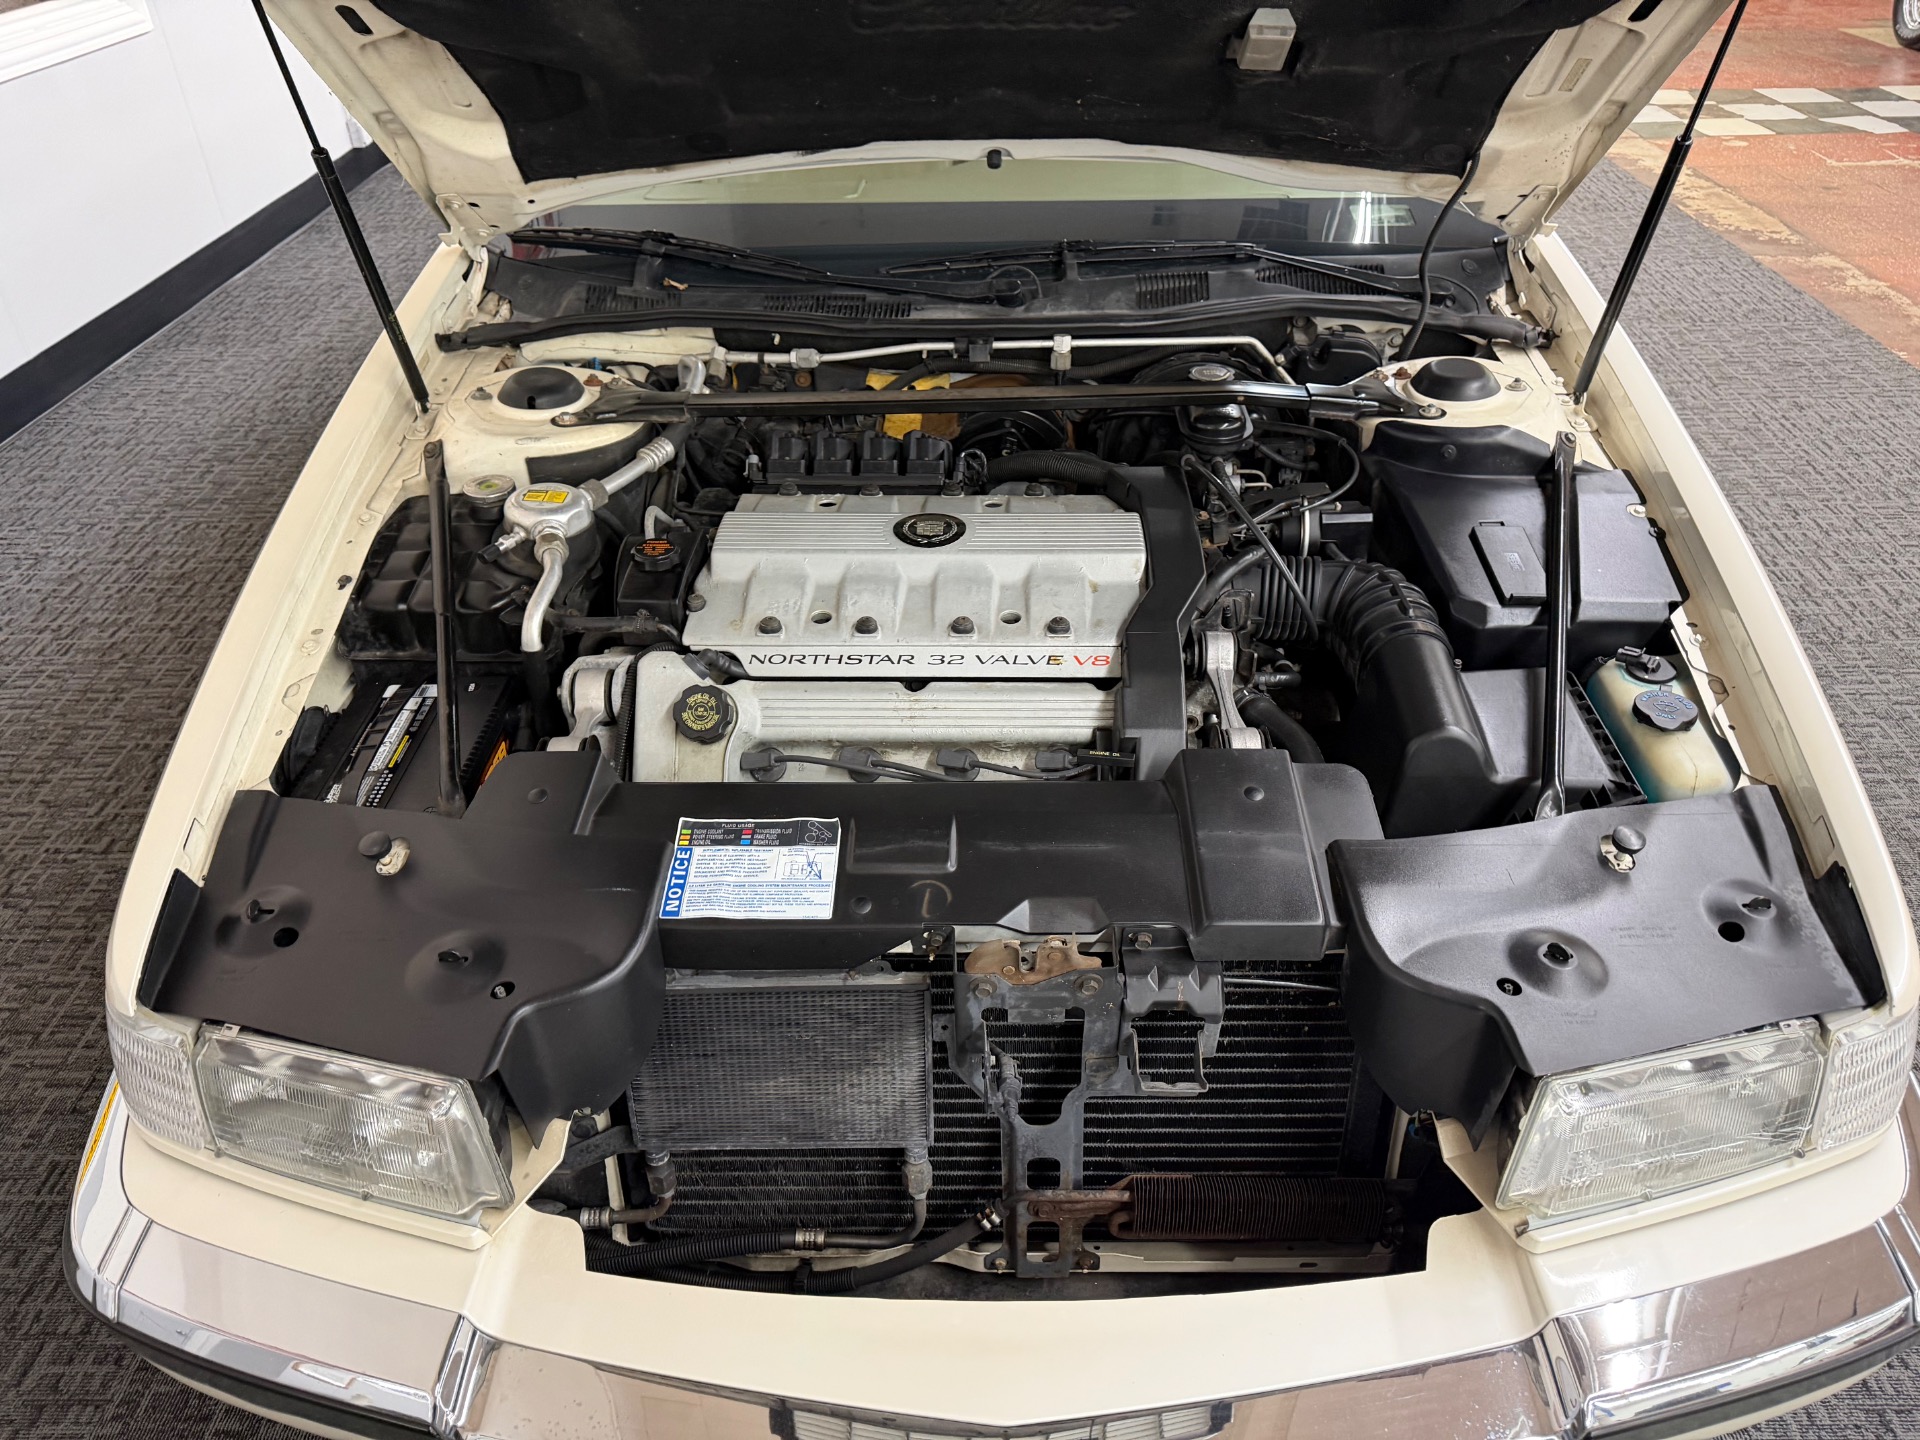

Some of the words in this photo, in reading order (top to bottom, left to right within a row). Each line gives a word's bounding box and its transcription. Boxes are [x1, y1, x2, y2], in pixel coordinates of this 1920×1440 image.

[748, 654, 915, 666] NORTHSTAR
[927, 654, 965, 666] 32
[975, 654, 1066, 667] VALVE
[1073, 655, 1111, 667] V8
[1641, 691, 1669, 702] WASHER
[1655, 711, 1677, 720] ONLY
[665, 850, 690, 912] NOTICE
